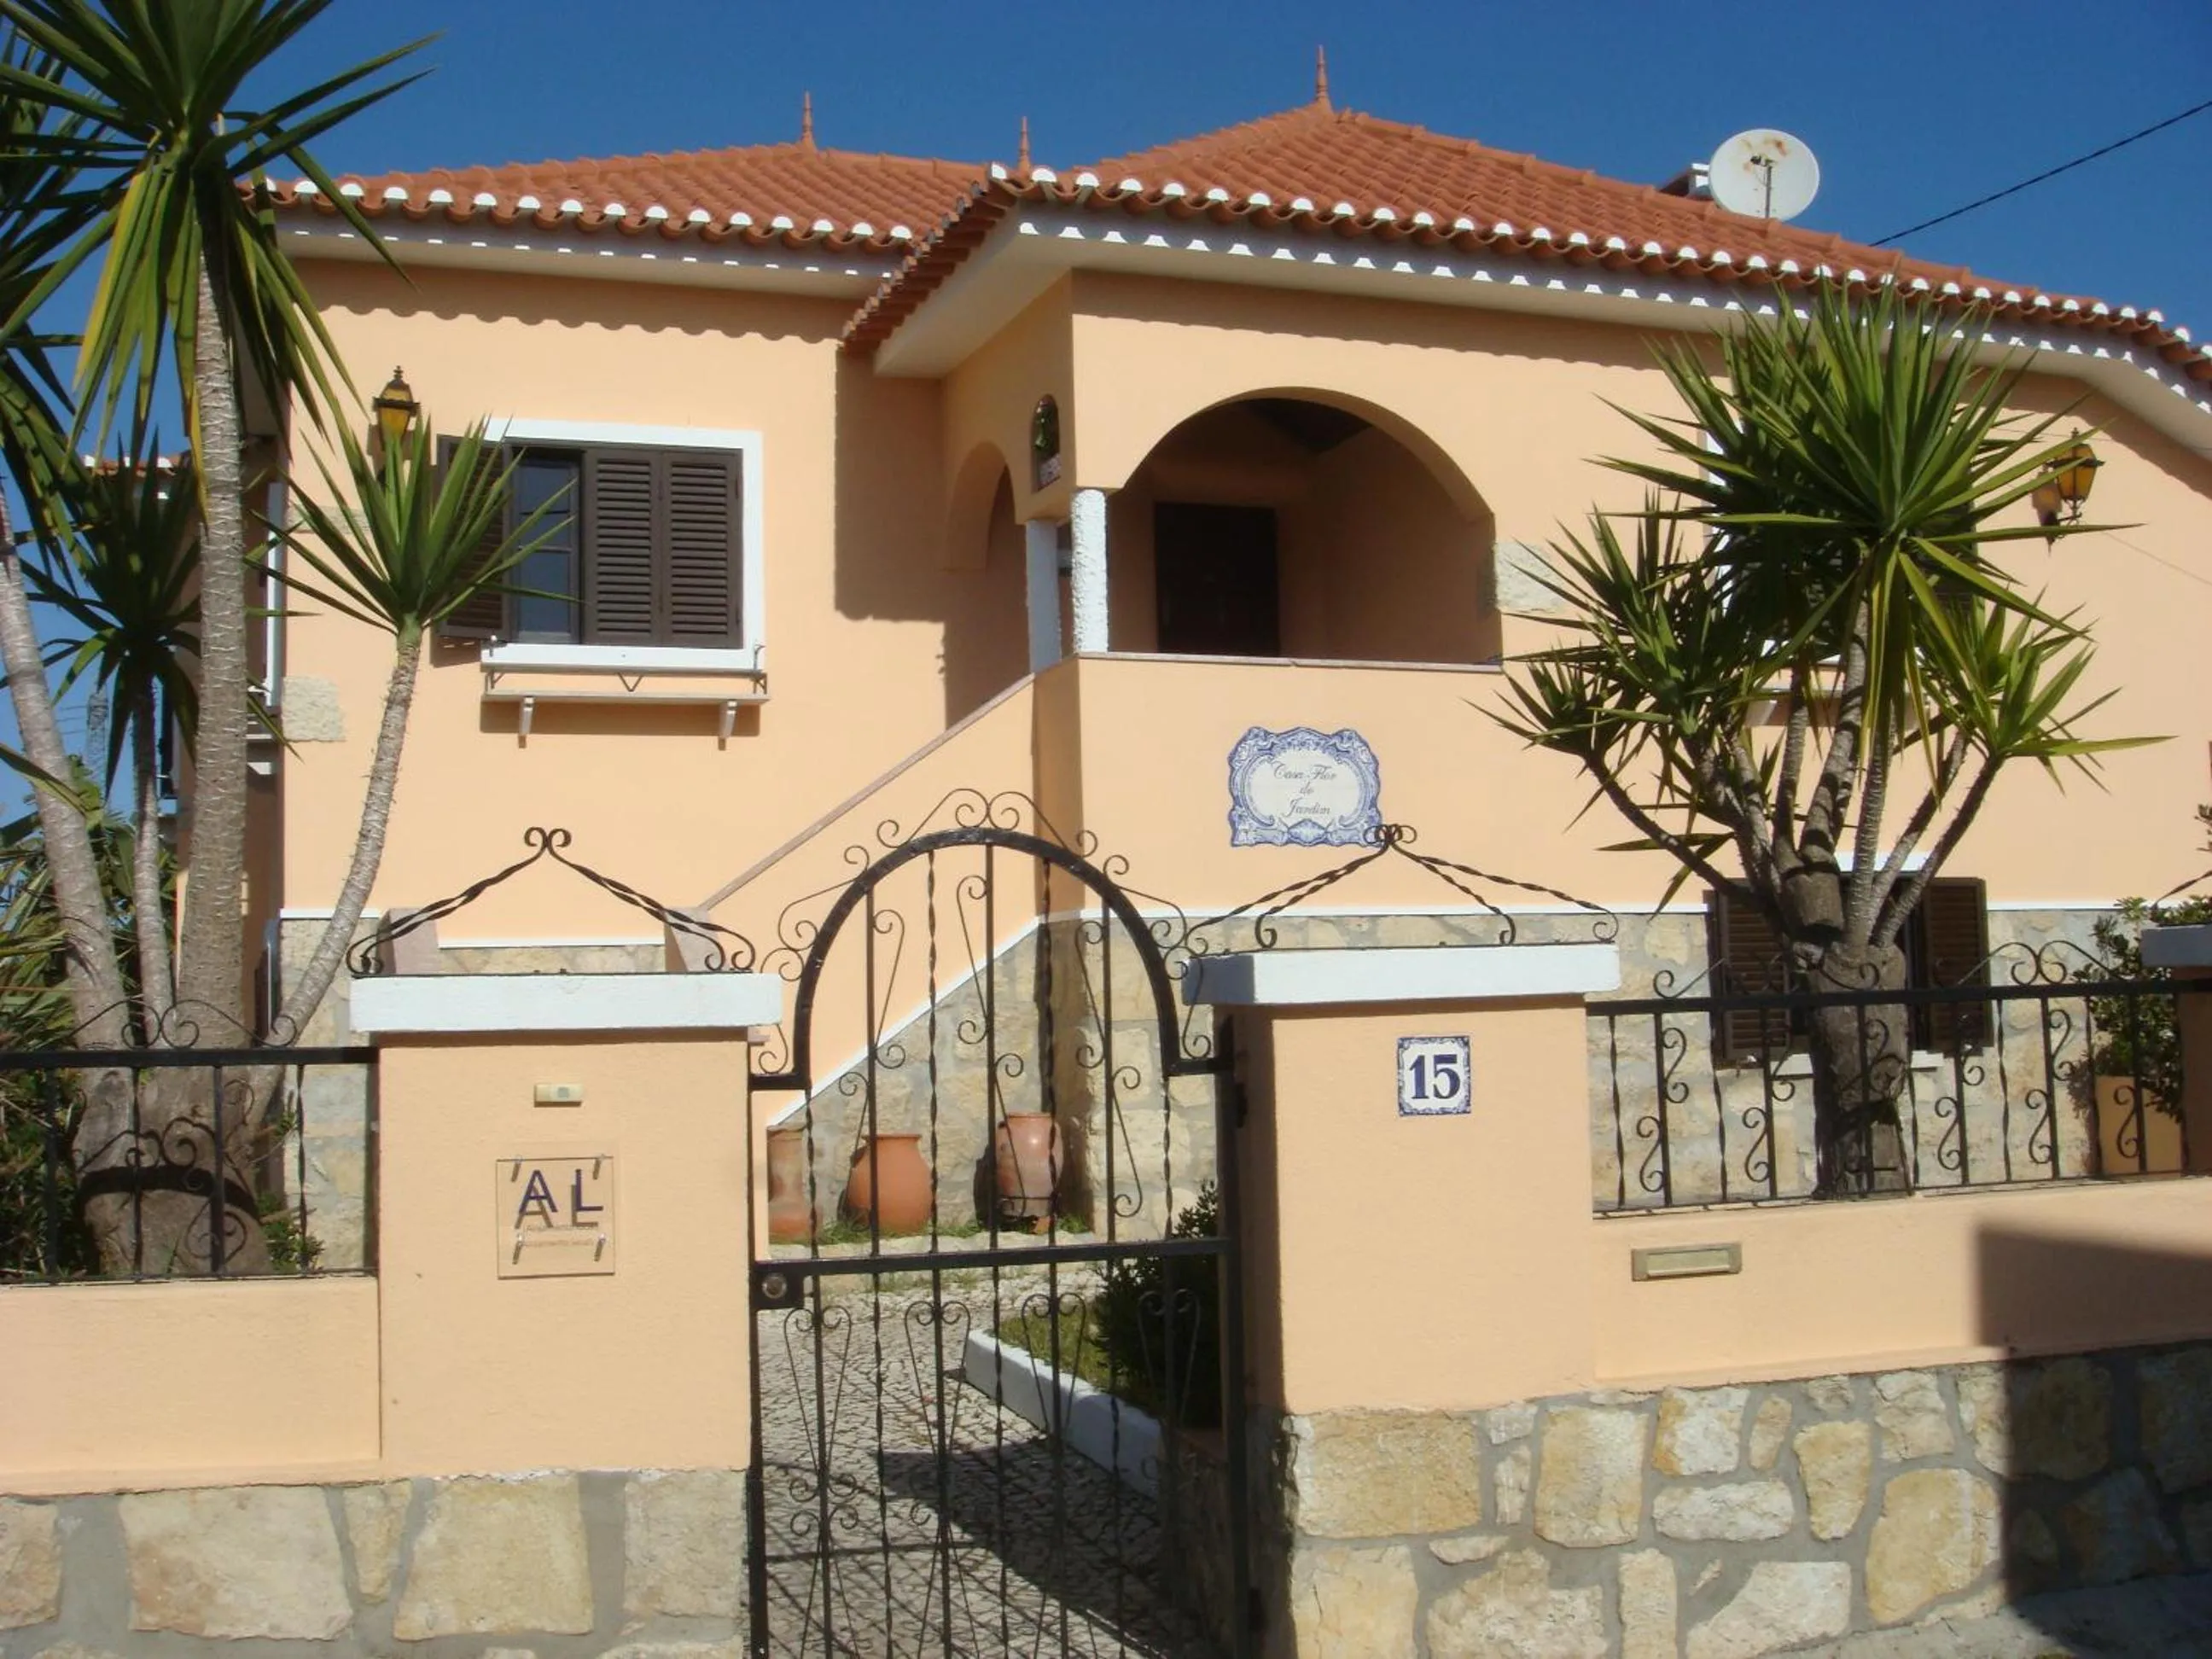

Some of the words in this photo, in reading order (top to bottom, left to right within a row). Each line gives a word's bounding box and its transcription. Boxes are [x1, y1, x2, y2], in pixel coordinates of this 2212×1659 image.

[1311, 764, 1337, 780] Flor
[1409, 1054, 1460, 1099] 15
[519, 1169, 604, 1213] AL
